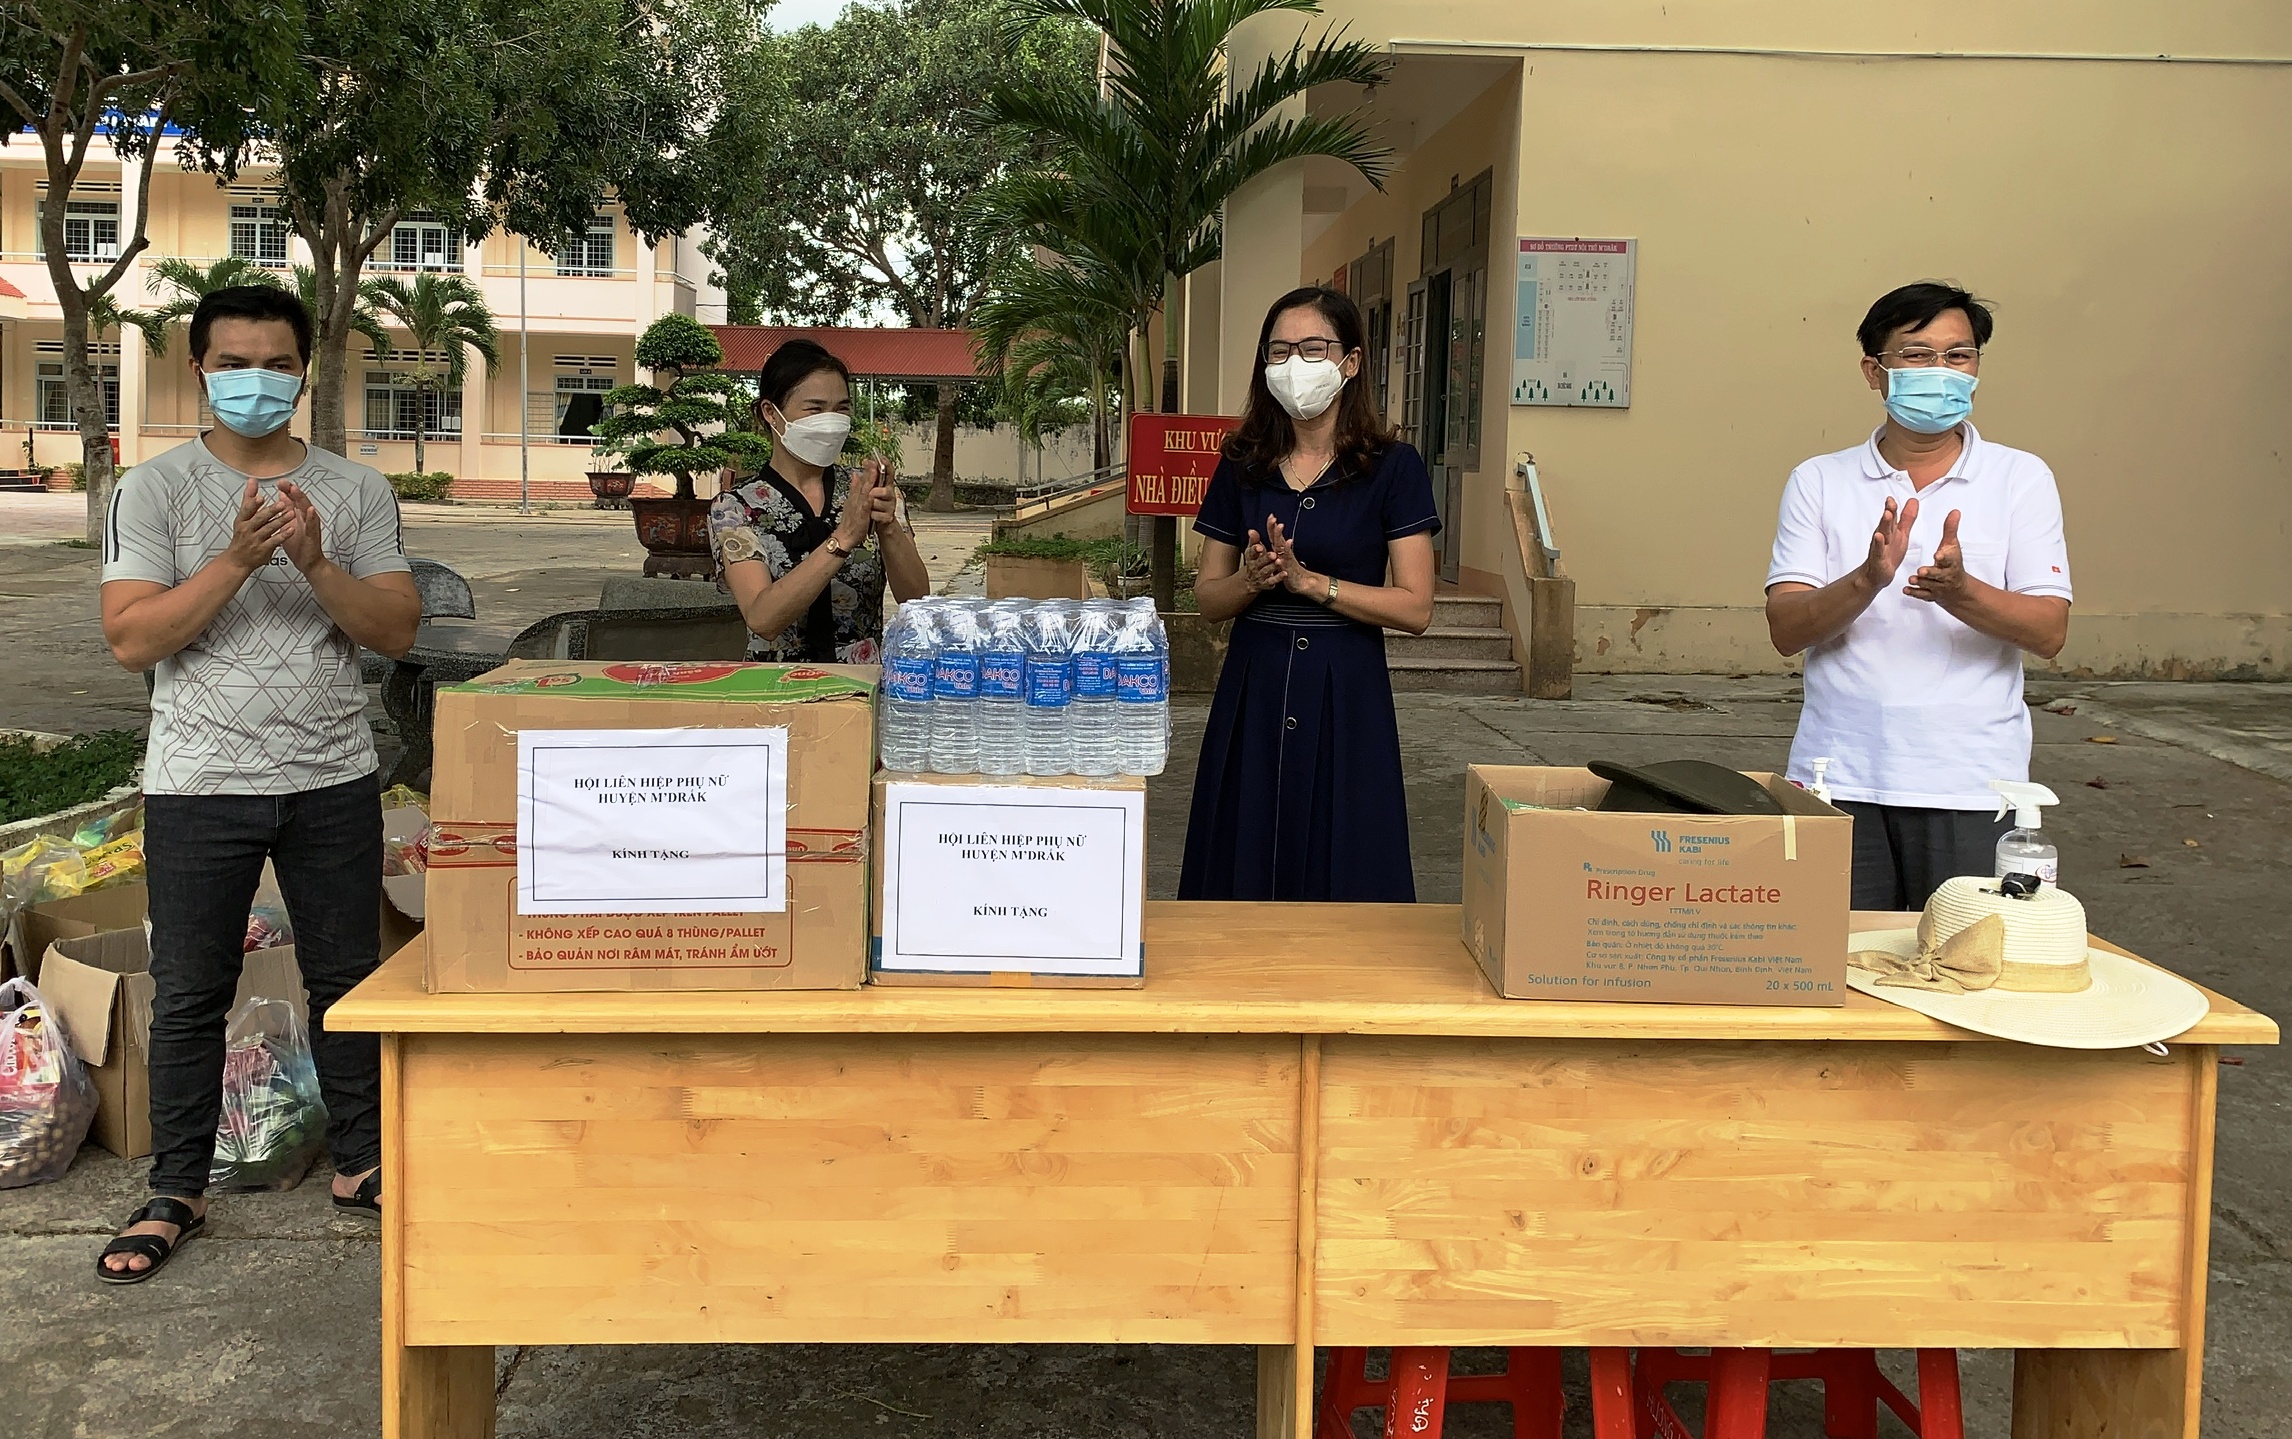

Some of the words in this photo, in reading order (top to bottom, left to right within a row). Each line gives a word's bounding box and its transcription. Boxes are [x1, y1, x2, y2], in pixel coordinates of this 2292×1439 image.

[1164, 430, 1196, 450] KHU
[1200, 428, 1226, 454] VỰ
[1134, 466, 1166, 504] NHÀ
[1170, 460, 1209, 505] ĐIỀU
[574, 777, 600, 791] HỘI
[604, 775, 636, 788] LIÊN
[640, 776, 673, 790] HIỆP
[677, 777, 705, 789] PHỤ
[708, 774, 730, 787] NỮ
[599, 791, 647, 806] HUYỆN
[938, 832, 963, 846] HỘI
[967, 831, 998, 845] LIÊN
[1001, 834, 1033, 848] HIỆP
[1036, 835, 1063, 849] PHỤ
[1066, 834, 1087, 847] NỮ
[1679, 835, 1730, 845] FRESENIUS
[612, 848, 647, 859] KÍNH
[650, 850, 690, 861] TẶNG
[961, 849, 1008, 862] HUYỆN
[1679, 846, 1702, 854] KABI
[1704, 858, 1715, 866] for
[1718, 858, 1730, 866] life
[1595, 867, 1637, 876] Prescription
[1638, 869, 1656, 877] Drug
[1587, 879, 1676, 906] Ringer
[1685, 883, 1781, 904] Lactate
[973, 903, 1007, 916] KÍNH
[1010, 906, 1048, 919] TẶNG
[526, 927, 573, 939] KHÔNG
[577, 926, 600, 939] XẾP
[603, 929, 632, 939] CAO
[635, 926, 663, 939] QUÁ
[666, 928, 674, 938] 8
[677, 926, 766, 939] THÙNG/PALLET
[526, 947, 553, 960] BẢO
[556, 946, 593, 960] QUẢN
[597, 948, 620, 960] NƠI
[623, 947, 651, 960] RÂM
[655, 946, 683, 960] MÁT,
[686, 946, 726, 959] TRÁNH
[730, 943, 750, 959] ẨM
[753, 945, 778, 958] ƯỚT
[1710, 954, 1746, 962] Fresenius
[1767, 956, 1783, 964] Việt
[1785, 956, 1803, 964] Nam
[1528, 973, 1578, 985] Solution
[1582, 975, 1599, 987] for
[1766, 980, 1780, 991] 20
[1793, 980, 1814, 991] 500
[1817, 981, 1834, 991] mL
